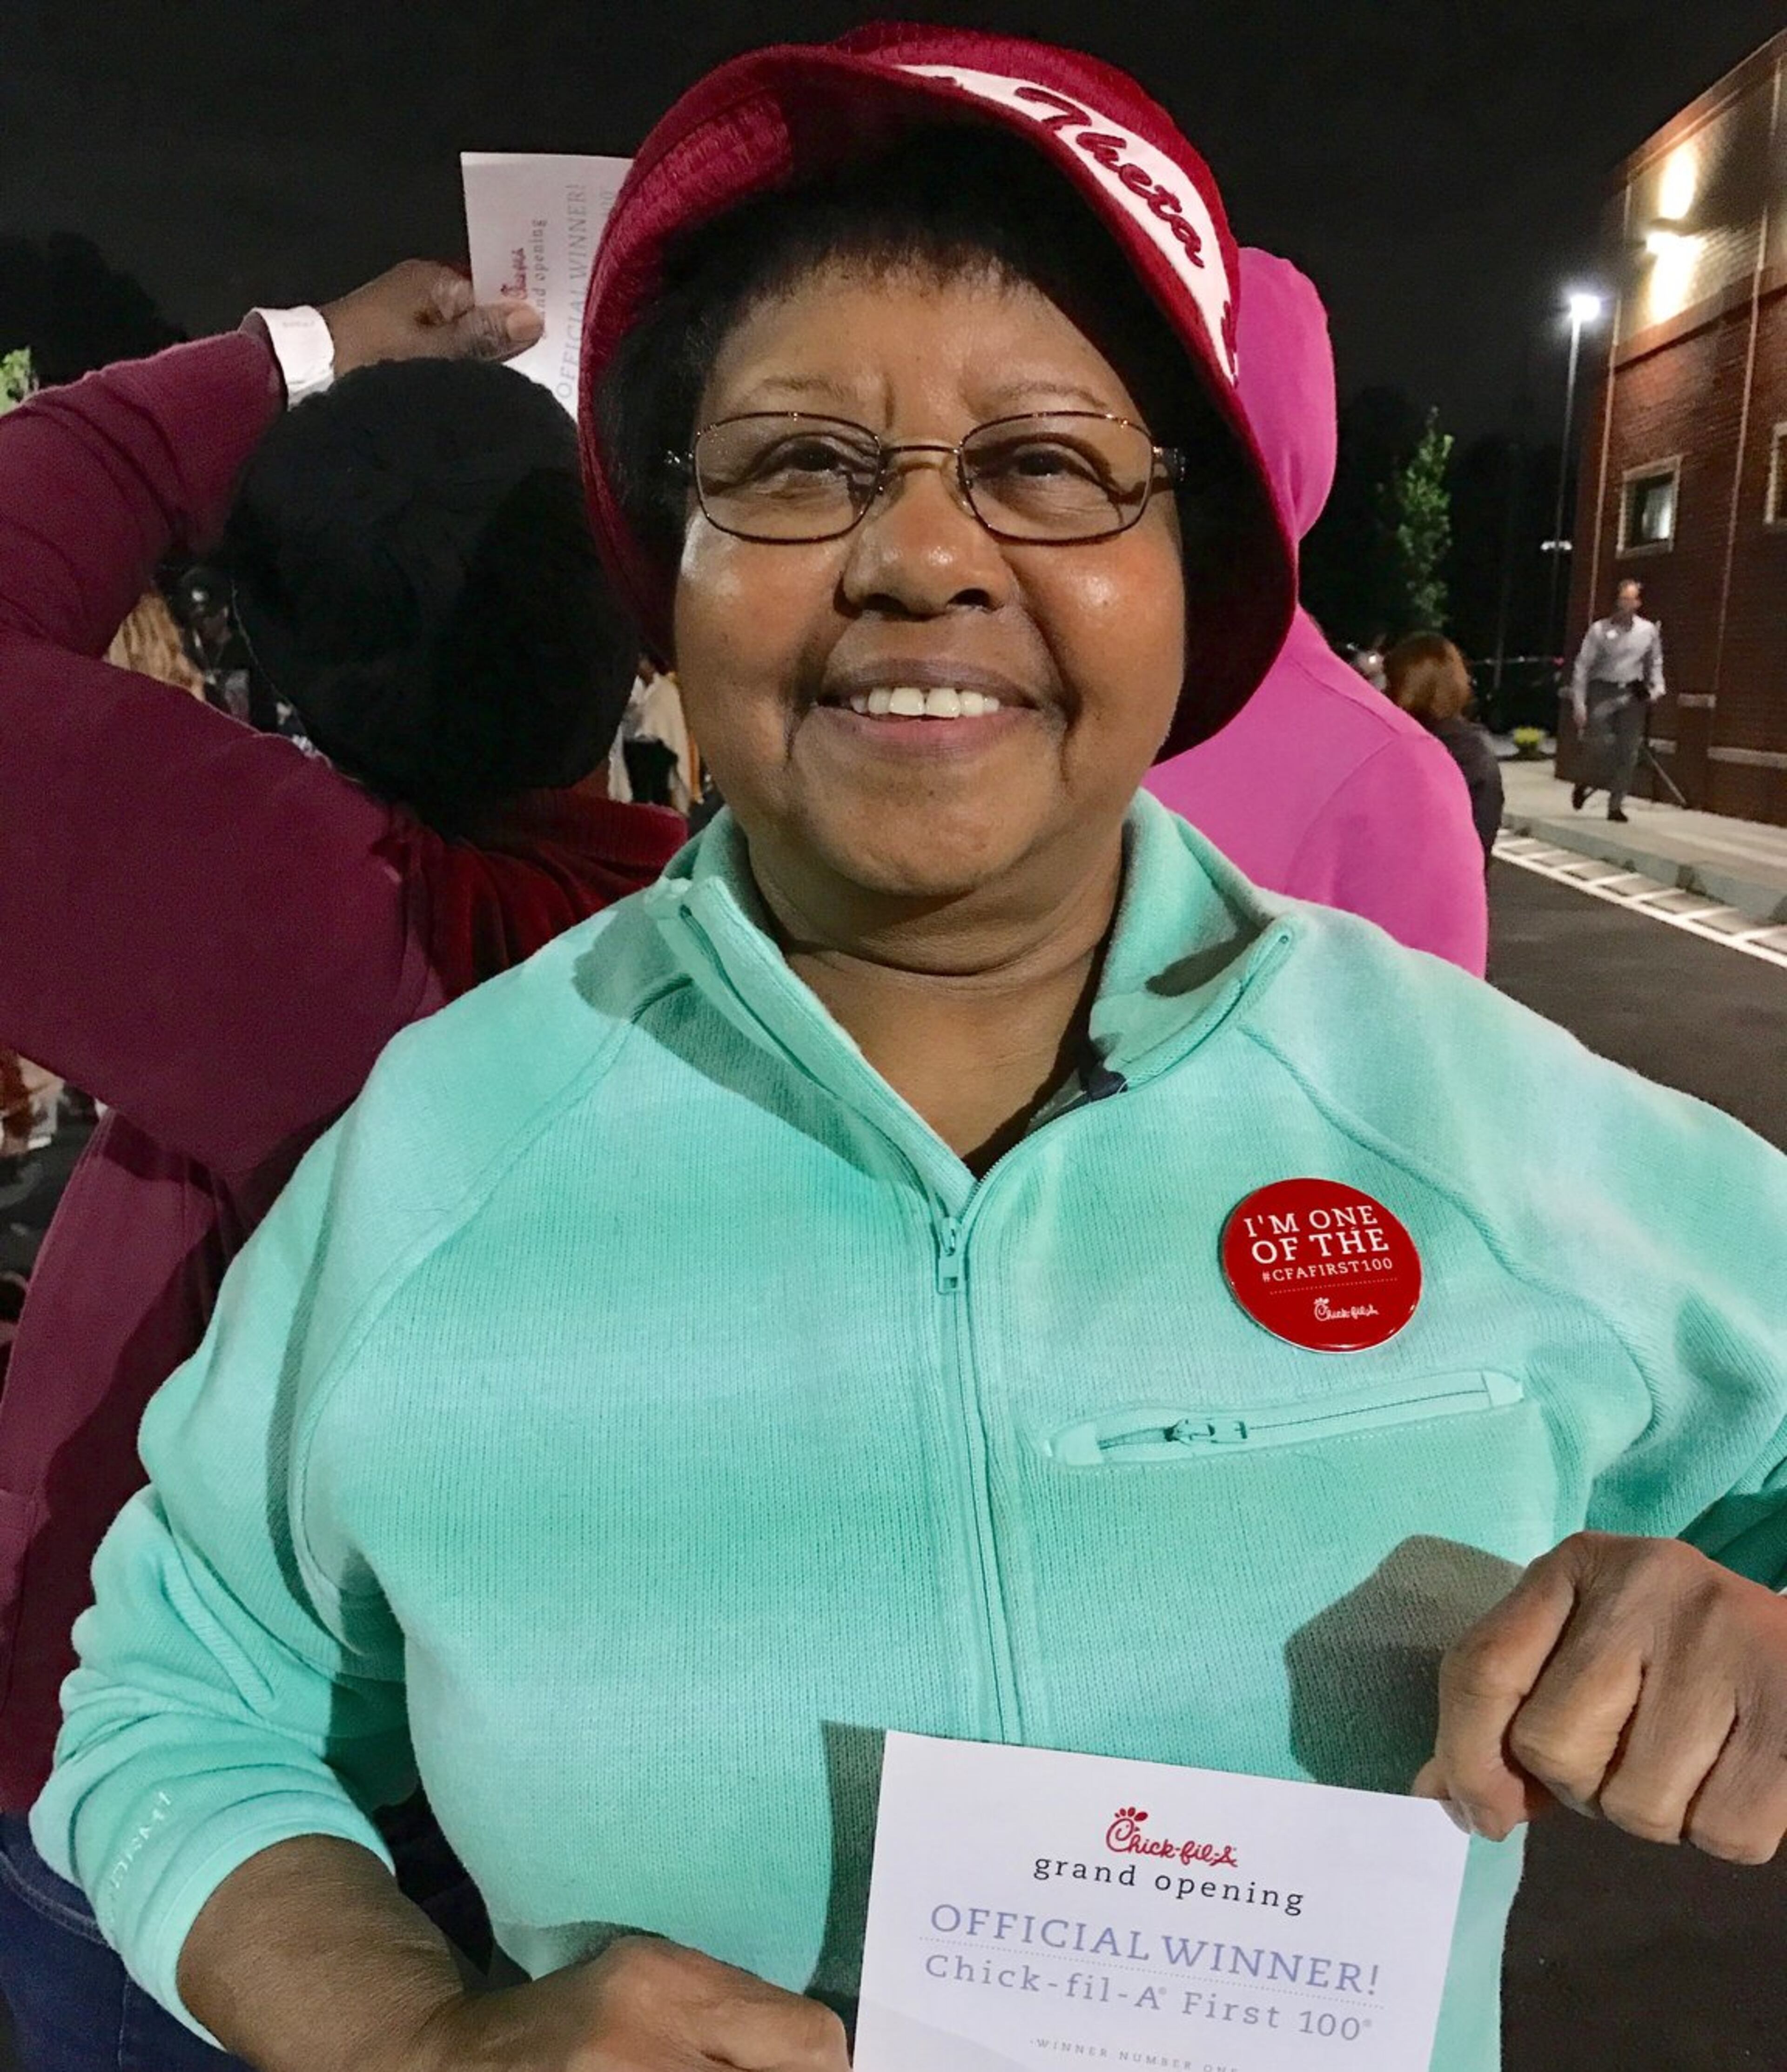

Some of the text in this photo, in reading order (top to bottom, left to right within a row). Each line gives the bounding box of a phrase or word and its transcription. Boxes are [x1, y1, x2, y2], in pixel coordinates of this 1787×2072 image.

[1014, 87, 1204, 268] Theta
[529, 219, 548, 280] opening
[565, 185, 588, 280] WINNER!
[1243, 1205, 1377, 1237] I'M ONE
[1252, 1228, 1389, 1264] OF THE
[1262, 1258, 1392, 1282] #CFAFIRST100
[1106, 1812, 1238, 1867] Chick-fil-A
[1034, 1858, 1303, 1916] grand opening
[931, 1904, 1378, 1996] OFFICIAL WINNER!
[1182, 1992, 1280, 2029] First
[1119, 2051, 1191, 2070] NUMBER
